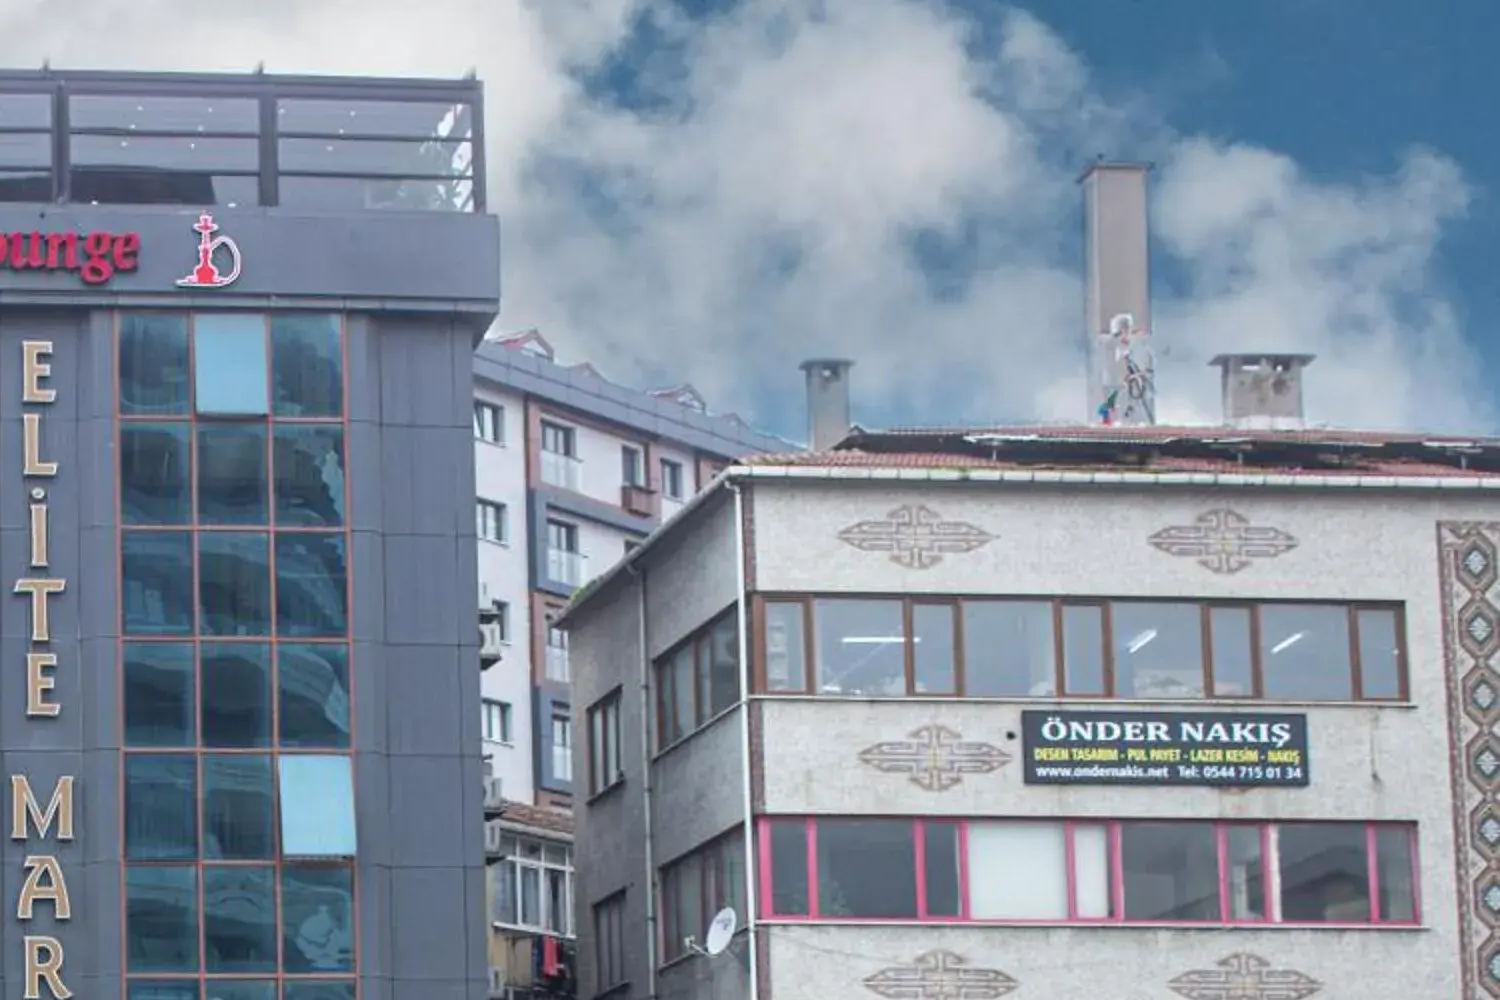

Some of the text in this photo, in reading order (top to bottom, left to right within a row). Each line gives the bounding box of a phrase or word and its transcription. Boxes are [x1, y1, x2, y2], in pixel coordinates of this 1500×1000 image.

[1041, 716, 1291, 748] ÖNDER NAKIŞ
[1178, 765, 1200, 778] Tel:
[1203, 766, 1235, 778] 0544
[1239, 766, 1262, 778] 715
[1266, 767, 1280, 779] 01
[1285, 767, 1301, 779] 34
